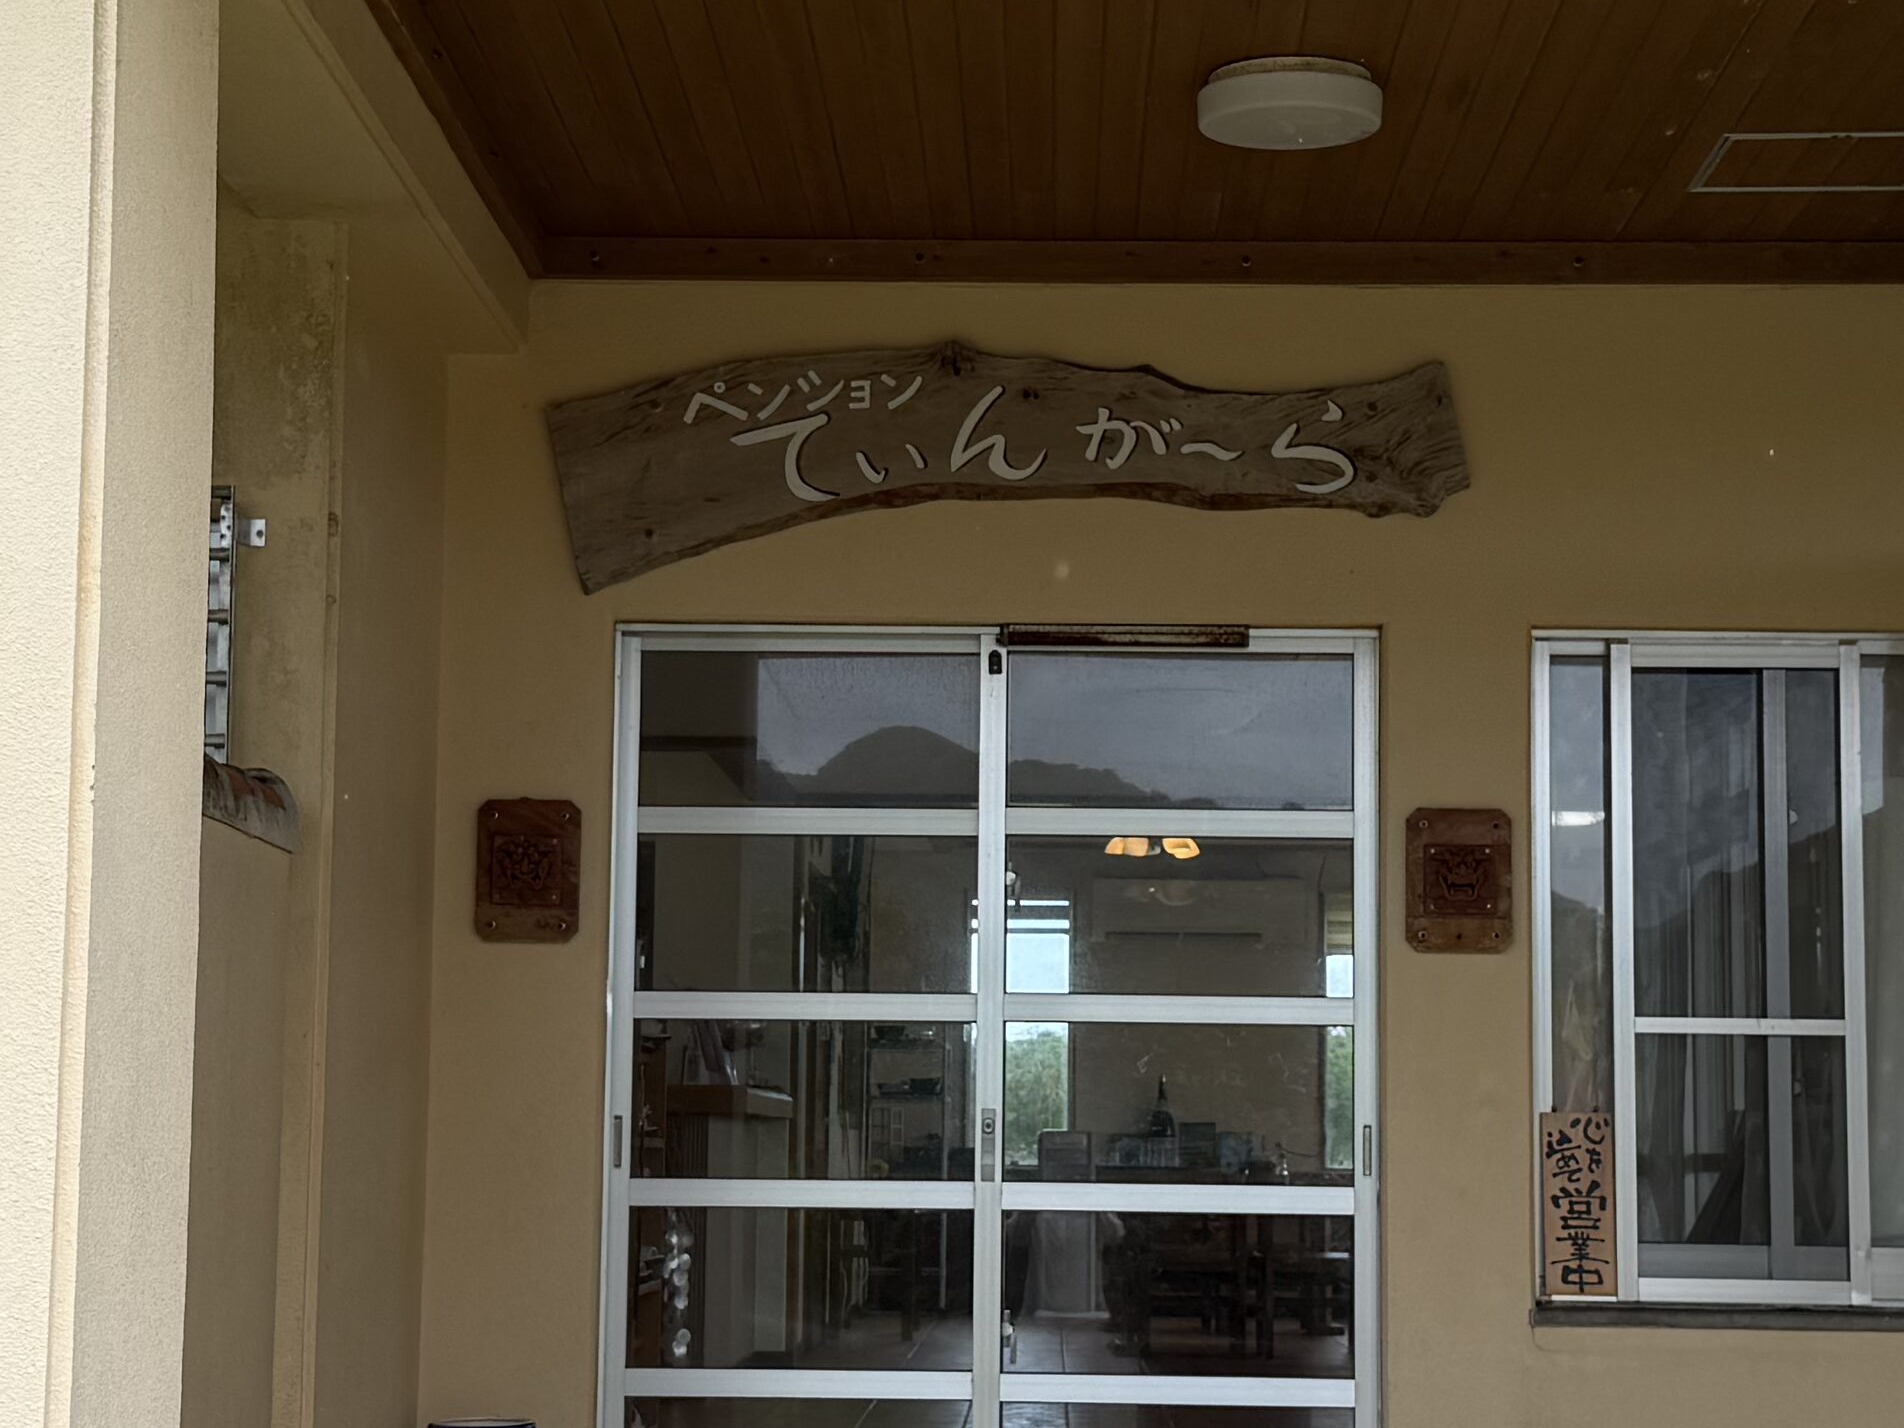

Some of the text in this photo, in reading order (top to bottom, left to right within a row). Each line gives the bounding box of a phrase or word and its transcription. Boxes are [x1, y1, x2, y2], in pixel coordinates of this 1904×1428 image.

[683, 367, 924, 423] ペンション
[1550, 1180, 1610, 1294] 営業中
